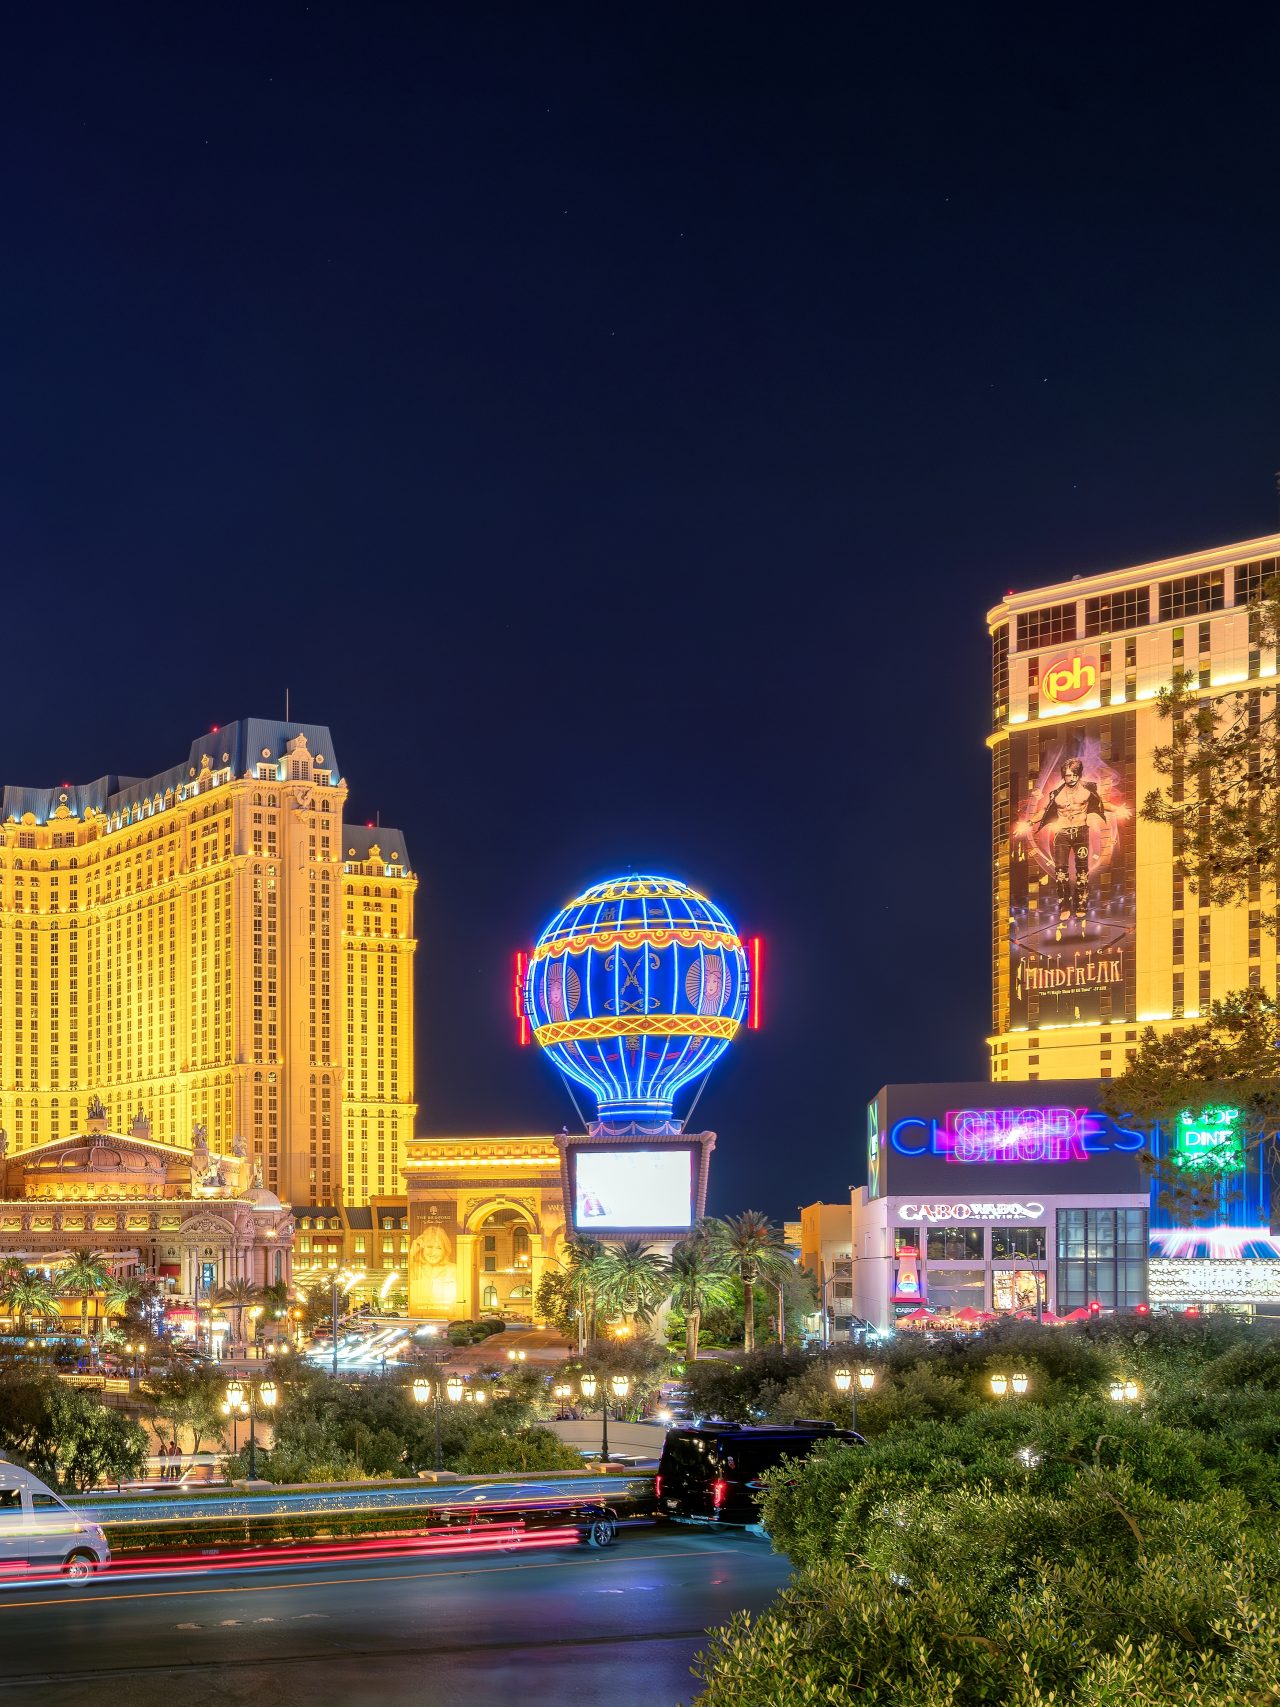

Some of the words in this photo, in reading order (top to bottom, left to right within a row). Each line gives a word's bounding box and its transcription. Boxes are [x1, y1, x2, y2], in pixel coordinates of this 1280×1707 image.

[1050, 657, 1096, 700] ph
[1021, 953, 1062, 962] CRISS
[1075, 947, 1124, 957] ANGEL
[1025, 960, 1121, 990] MINDFREAK
[1185, 1130, 1234, 1147] DINE
[898, 1203, 971, 1222] CABO
[970, 1203, 1027, 1215] WABO
